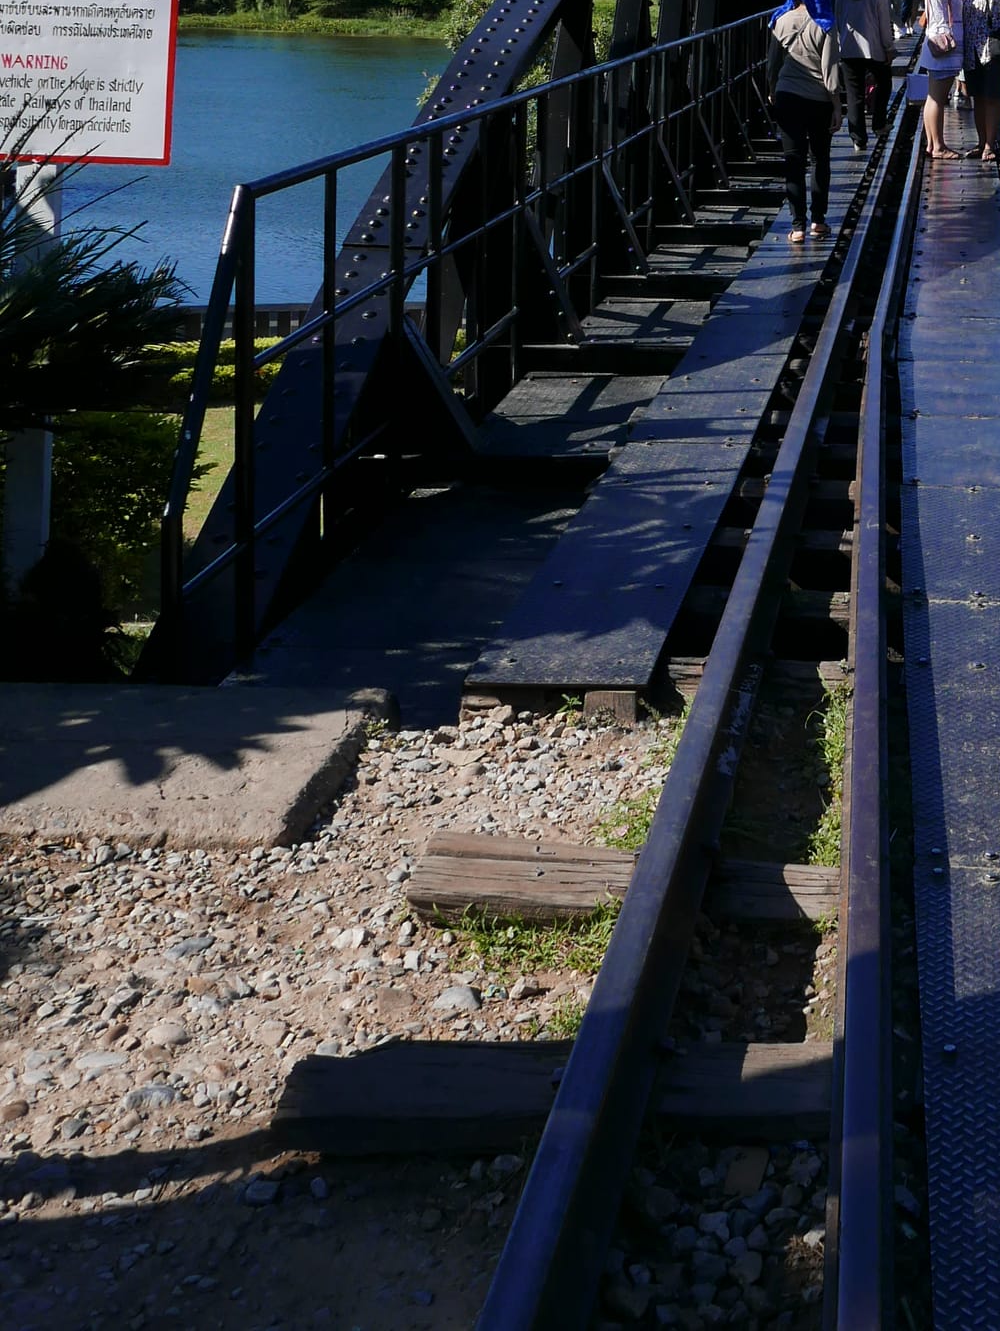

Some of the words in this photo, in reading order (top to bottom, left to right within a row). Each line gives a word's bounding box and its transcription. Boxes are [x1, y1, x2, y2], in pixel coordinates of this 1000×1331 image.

[1, 53, 68, 69] WARNING
[0, 73, 33, 88] vehicle
[96, 77, 105, 91] is
[109, 78, 144, 95] strictly
[74, 96, 85, 111] of
[89, 97, 131, 112] thailand
[87, 116, 131, 133] accidents
